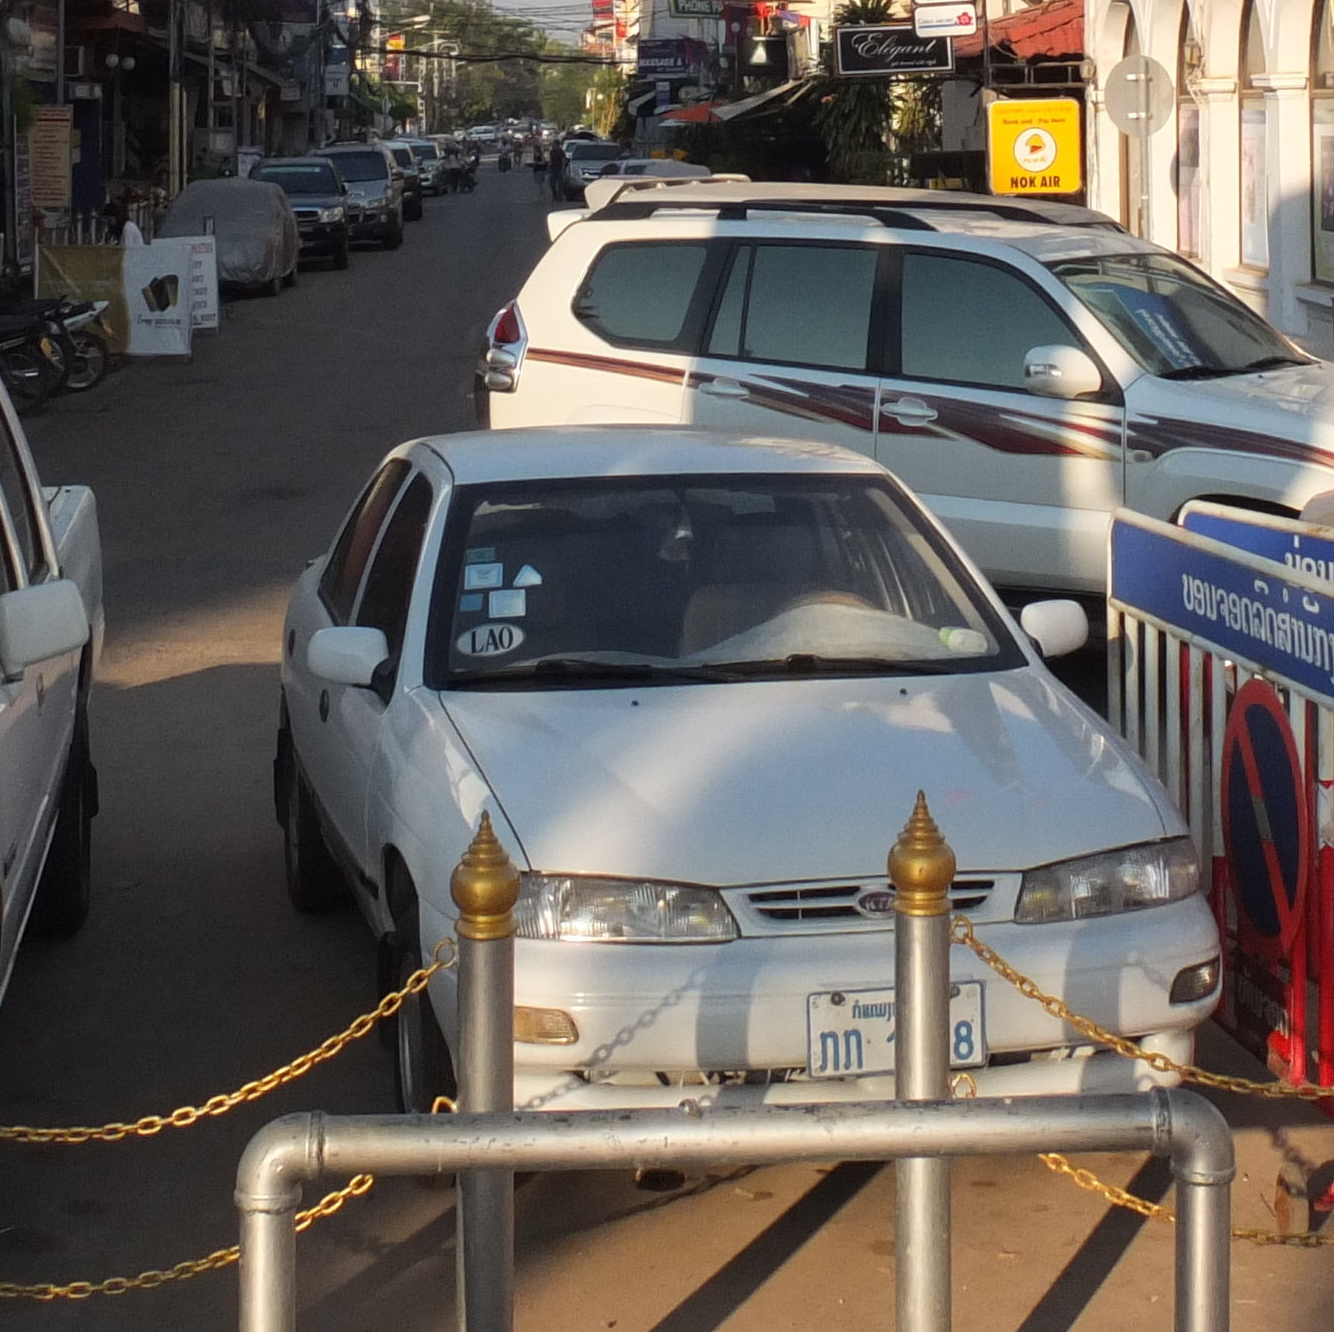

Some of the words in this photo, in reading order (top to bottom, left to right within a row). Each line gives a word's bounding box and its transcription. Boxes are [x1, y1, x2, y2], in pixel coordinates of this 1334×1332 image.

[678, 0, 710, 13] PHONE
[1010, 176, 1037, 189] NOK
[1040, 175, 1061, 188] AIR
[471, 626, 515, 654] LAO
